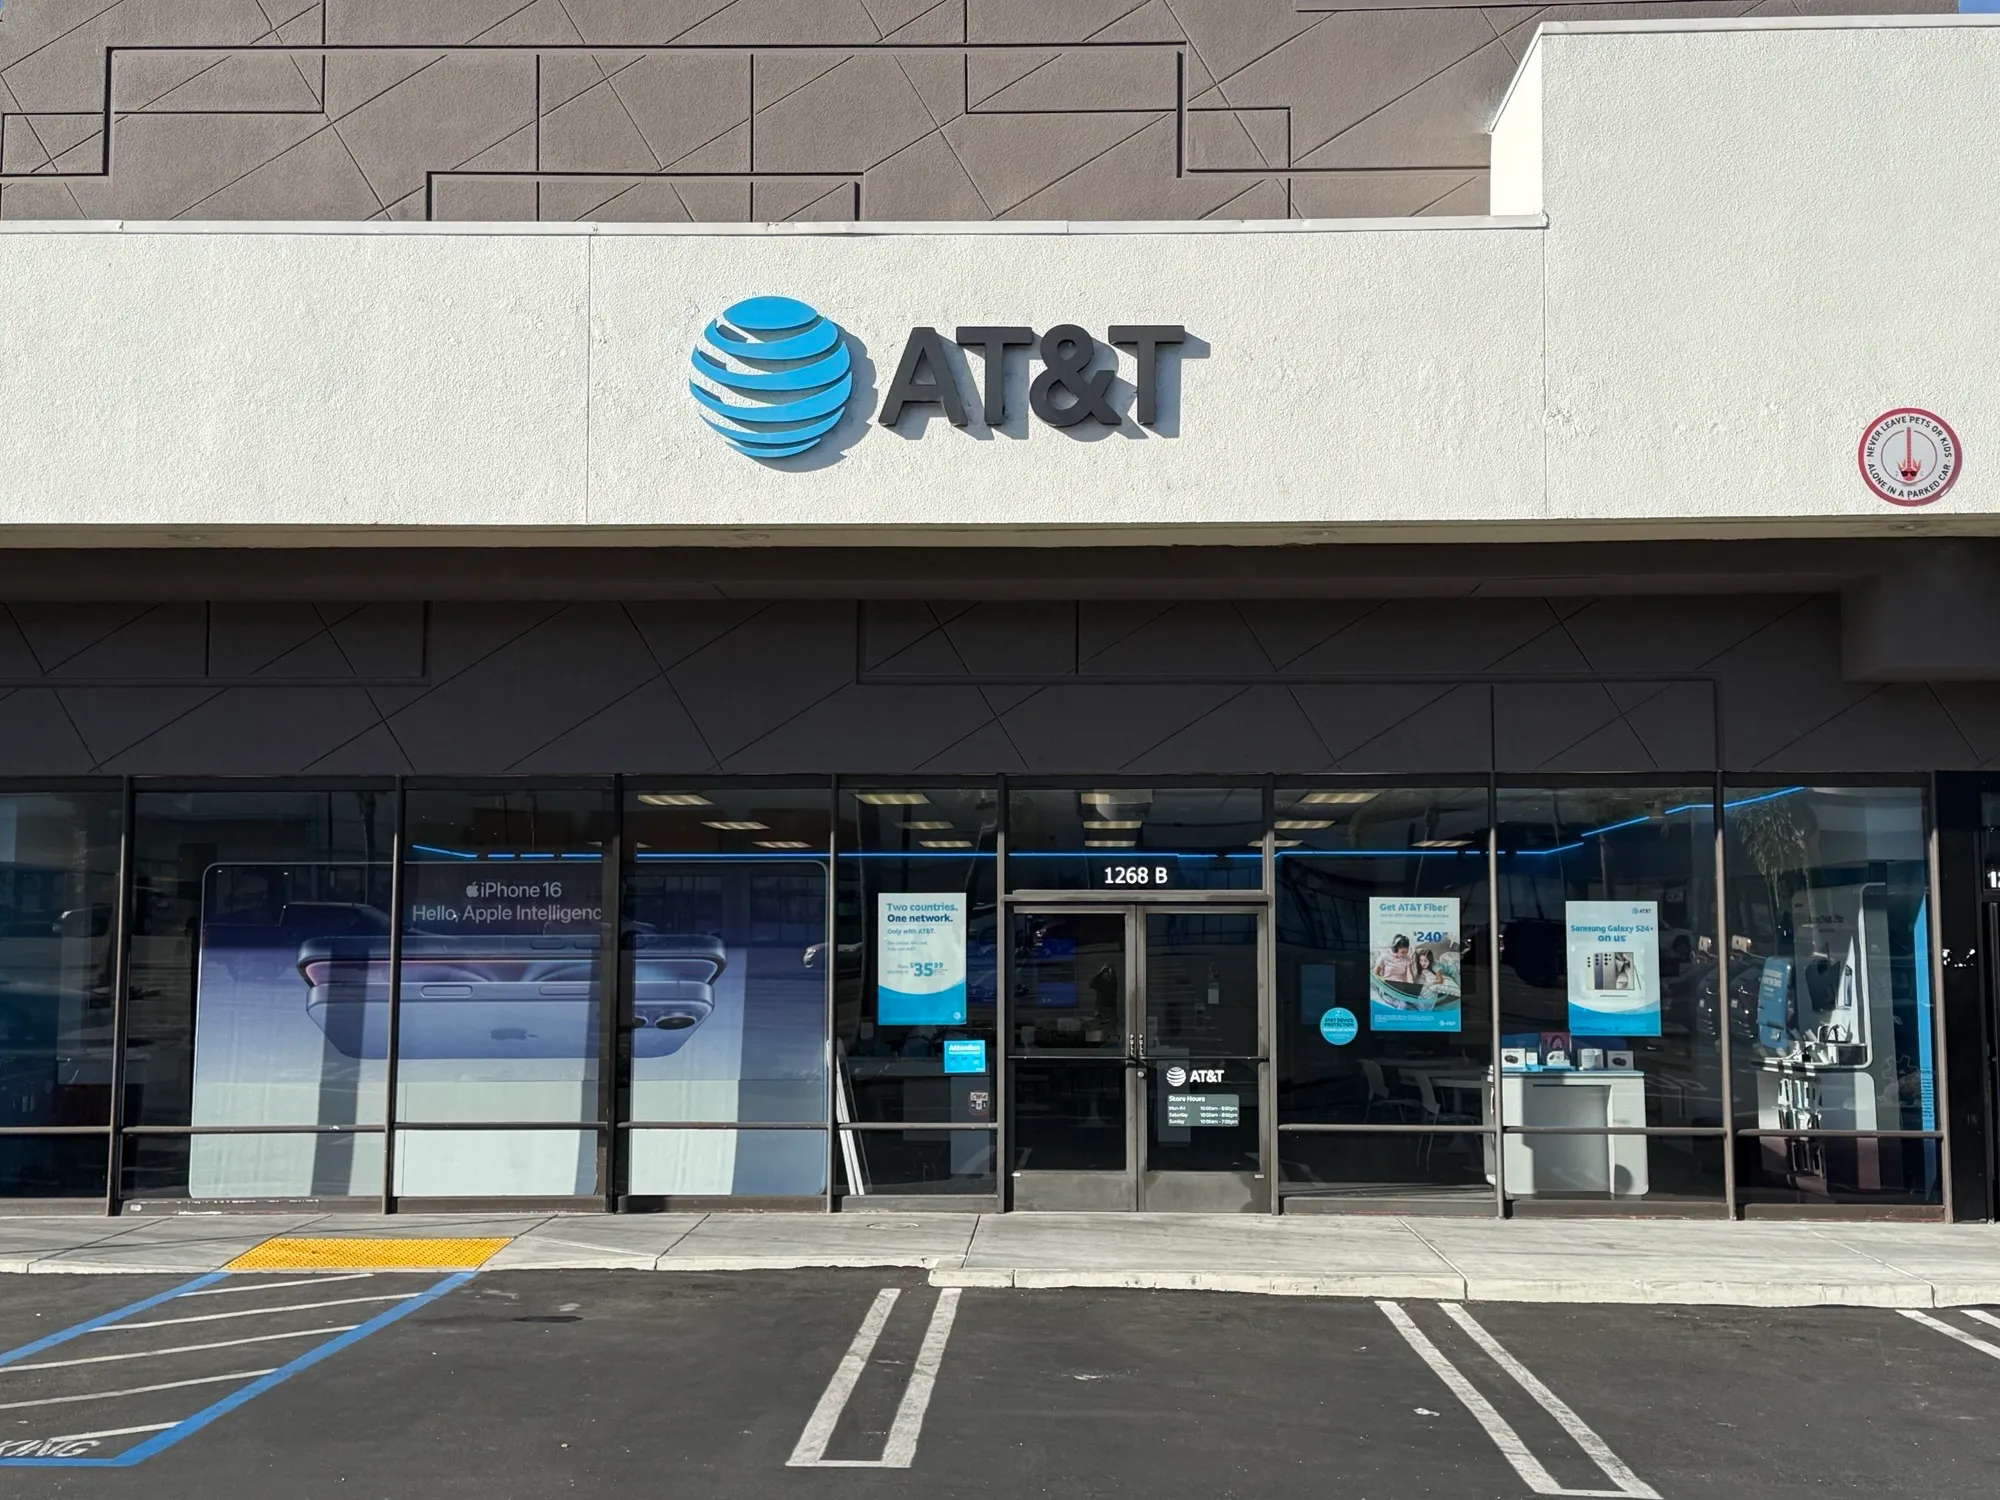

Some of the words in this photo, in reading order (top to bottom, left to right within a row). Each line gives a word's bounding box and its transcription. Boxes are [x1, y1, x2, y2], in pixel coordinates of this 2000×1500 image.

[878, 324, 1185, 428] AT&T
[1866, 430, 1882, 457] NEVER
[1880, 416, 1907, 431] LEAVE
[1909, 416, 1932, 428] PETS
[1931, 425, 1943, 438] OR
[1939, 437, 1952, 458] KIDS
[1867, 463, 1888, 489] ALONE
[1887, 485, 1897, 495] IN
[1898, 490, 1904, 498] A
[1907, 480, 1940, 499] PARKED
[1938, 464, 1951, 481] CAR
[1104, 867, 1149, 884] 1268
[1155, 867, 1168, 884] B
[480, 882, 540, 898] iPhone
[542, 882, 562, 898] 16
[412, 905, 460, 923] Hello,
[462, 905, 512, 923] Apple
[886, 903, 908, 912] Two
[910, 902, 958, 912] countries.
[1379, 903, 1396, 911] Get
[1398, 903, 1422, 911] AT&T
[887, 914, 907, 923] One
[909, 913, 953, 923] network.
[887, 928, 901, 936] Only
[1571, 925, 1606, 933] Samsung
[1607, 925, 1634, 934] Galaxy
[1189, 1070, 1225, 1083] AT&T
